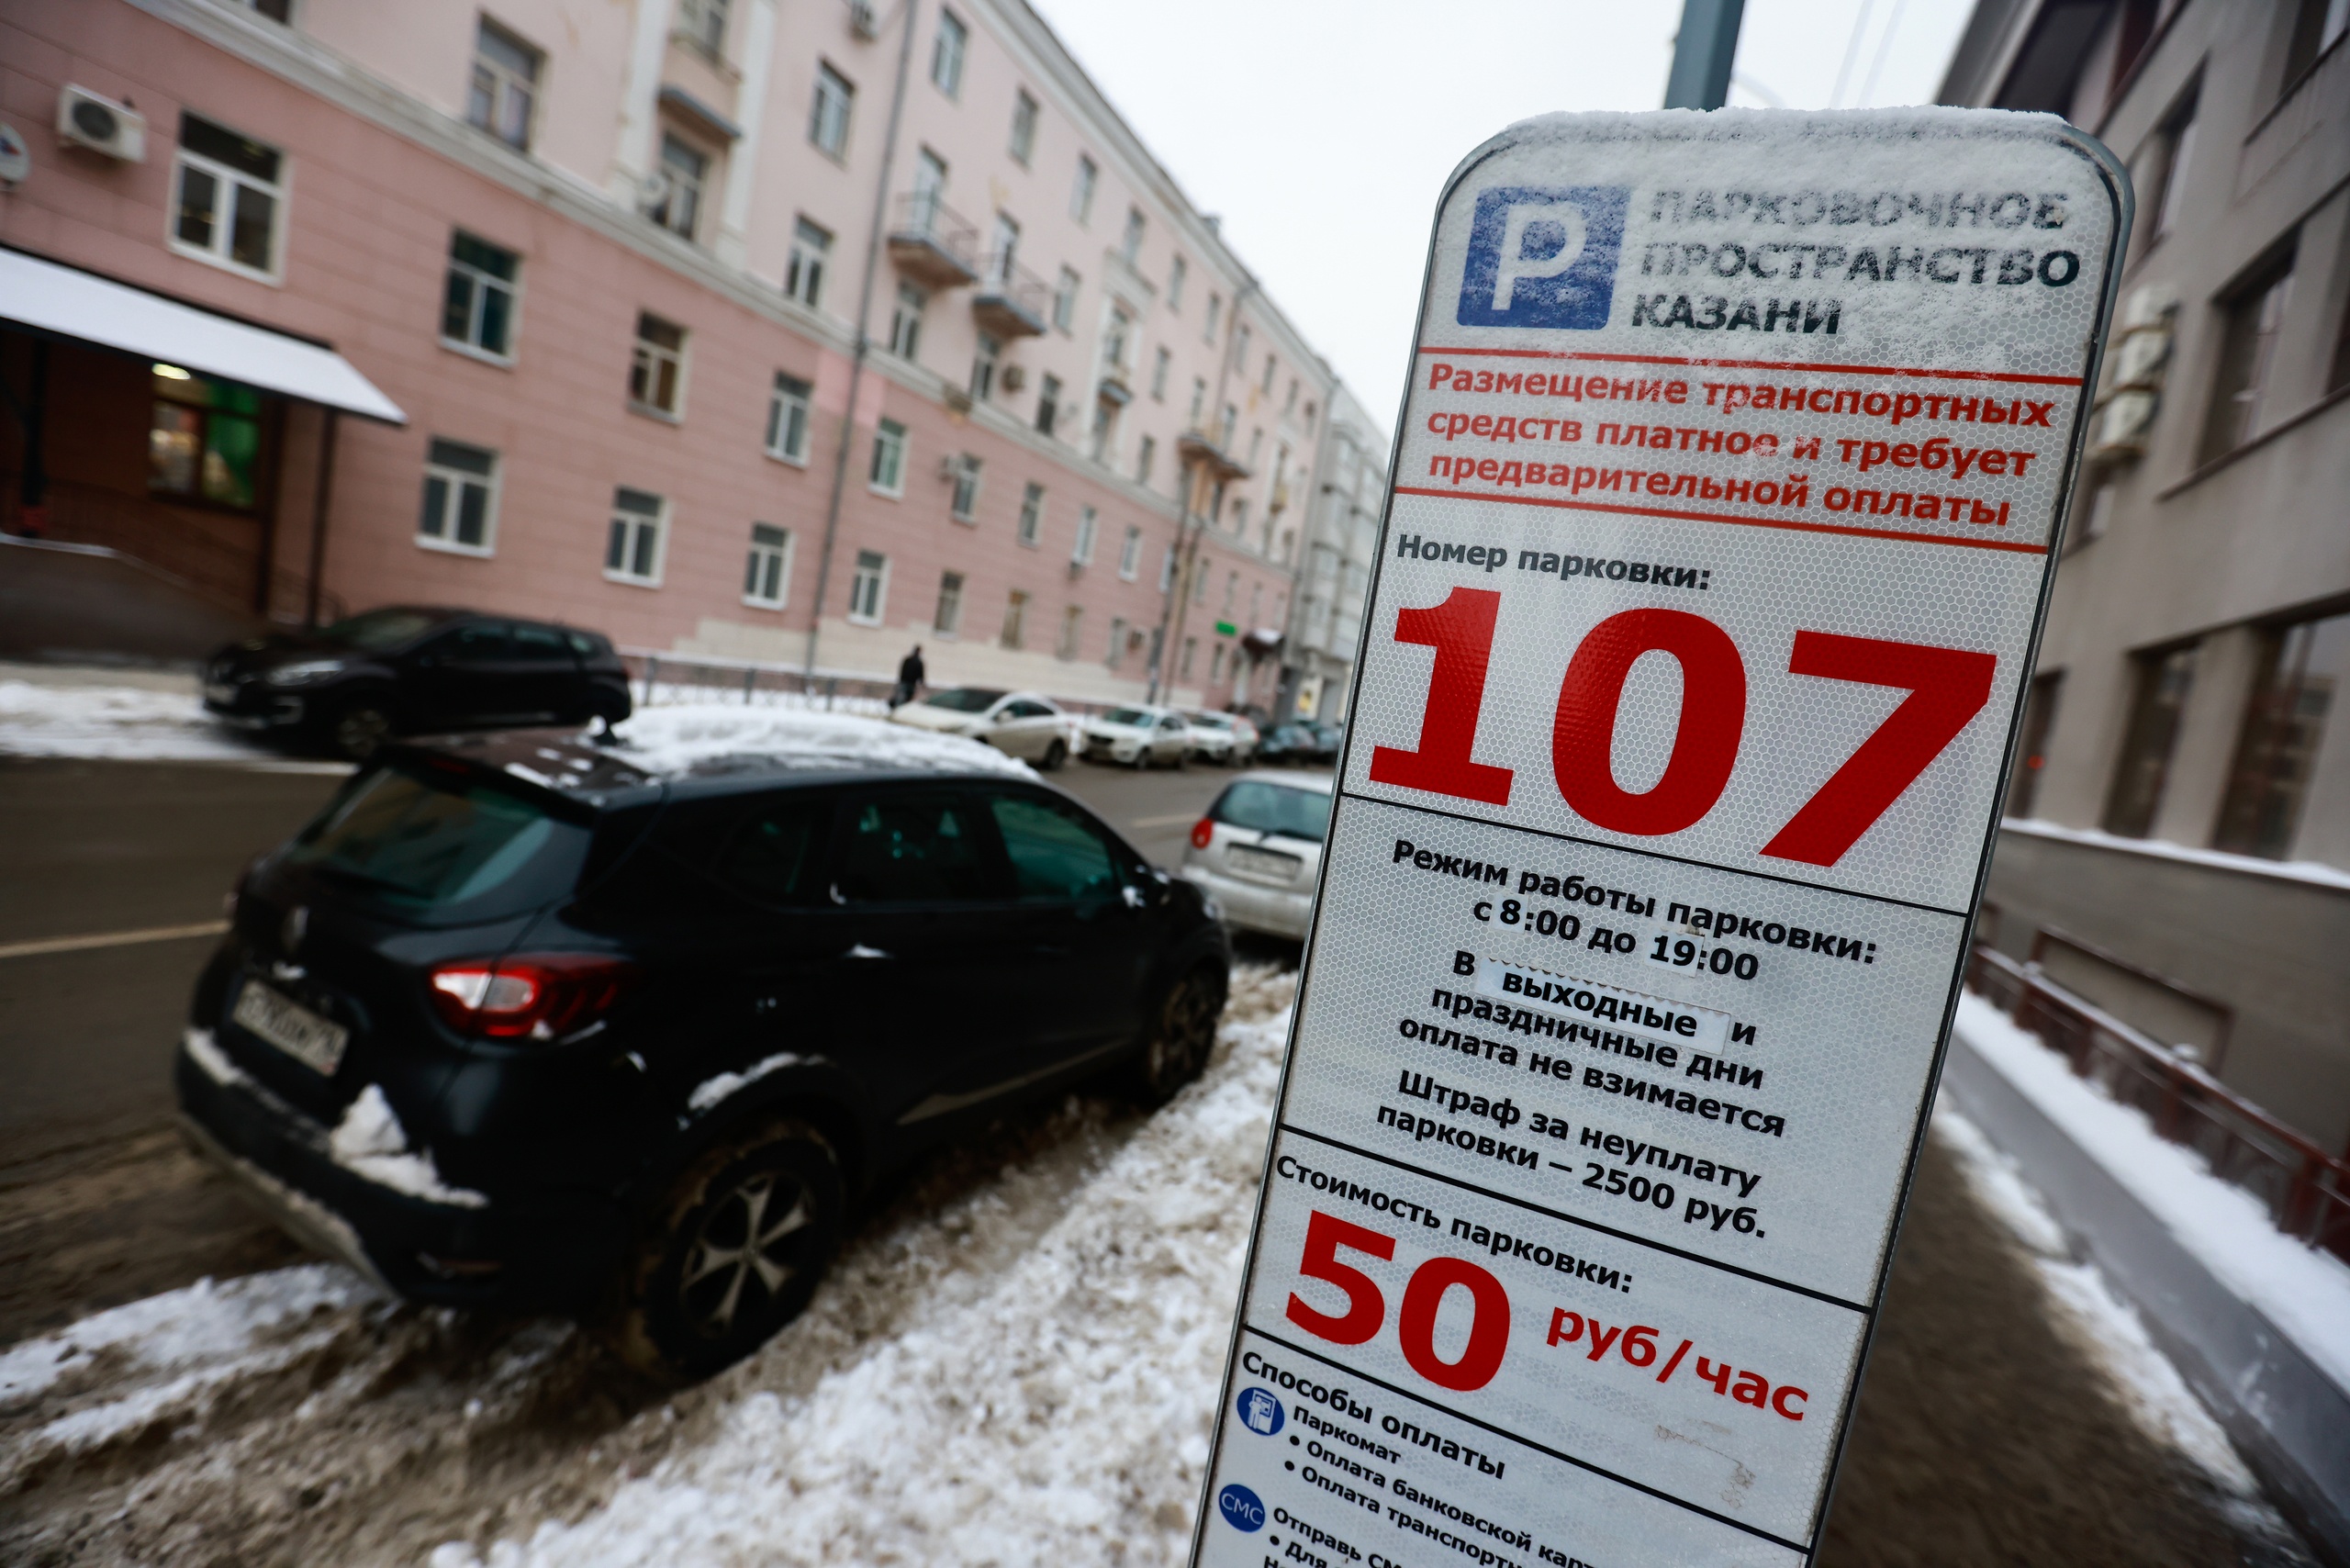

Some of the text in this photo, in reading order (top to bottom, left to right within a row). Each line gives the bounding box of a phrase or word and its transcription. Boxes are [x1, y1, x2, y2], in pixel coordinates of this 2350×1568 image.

[1651, 191, 2070, 230] ПАРКОВОЧНОЕ
[1640, 242, 2080, 287] ПРОСТРАНСТВО
[1632, 294, 1842, 335] КАЗАНИ
[1427, 364, 2055, 427] Размещение транспортных
[1427, 409, 2036, 478] средств платное и требует
[1428, 454, 2012, 526] предварительной оплаты
[1397, 534, 1711, 590] Номер парковки:
[1369, 587, 1997, 868] 107
[1393, 840, 1876, 964] Режим работы парковки:
[1474, 900, 1759, 980] с 8:00 до 19:00
[1453, 951, 1756, 1045] В выходные и
[1400, 1019, 1785, 1137] оплата не взимается
[1431, 989, 1763, 1090] праздничные дни
[1377, 1106, 1539, 1170] парковки
[1583, 1164, 1674, 1209] 2500
[1684, 1198, 1765, 1238] руб.
[1399, 1070, 1761, 1197] Штраф за неуплату
[1276, 1156, 1632, 1293] Стоимость парковки:
[1286, 1210, 1808, 1421] 50 руб/час
[1242, 1352, 1505, 1479] Способы оплаты
[1293, 1406, 1401, 1464] Паркомат
[1221, 1493, 1263, 1526] СМС
[1302, 1466, 1381, 1514] Оплата
[1307, 1440, 1386, 1488] Оплата
[1393, 1479, 1532, 1551] банковской
[1273, 1507, 1361, 1561] Отправь
